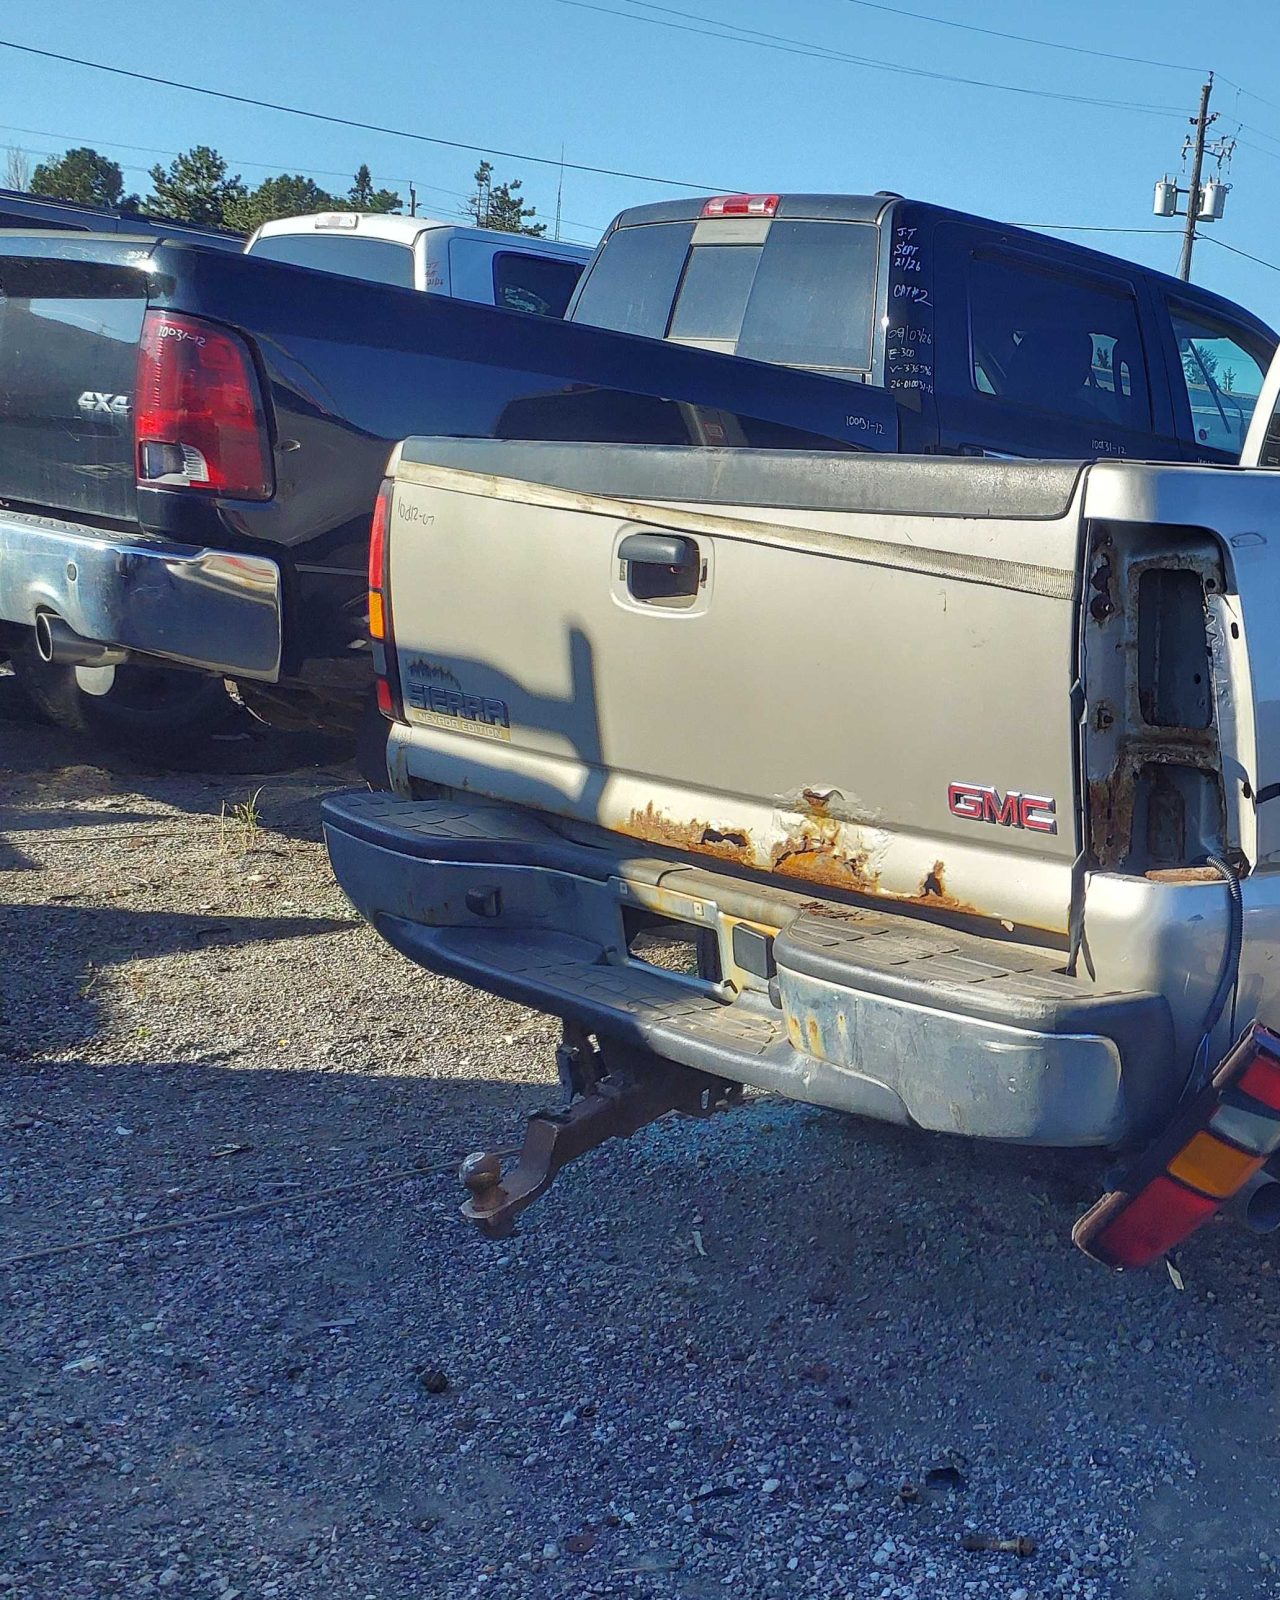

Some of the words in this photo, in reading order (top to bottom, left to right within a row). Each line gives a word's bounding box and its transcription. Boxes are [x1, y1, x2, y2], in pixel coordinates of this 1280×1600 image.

[894, 241, 919, 256] SEPT
[407, 681, 511, 729] SIERRA
[418, 712, 461, 730] NEVADA
[461, 721, 502, 739] EDITION
[948, 781, 1057, 835] GMC
